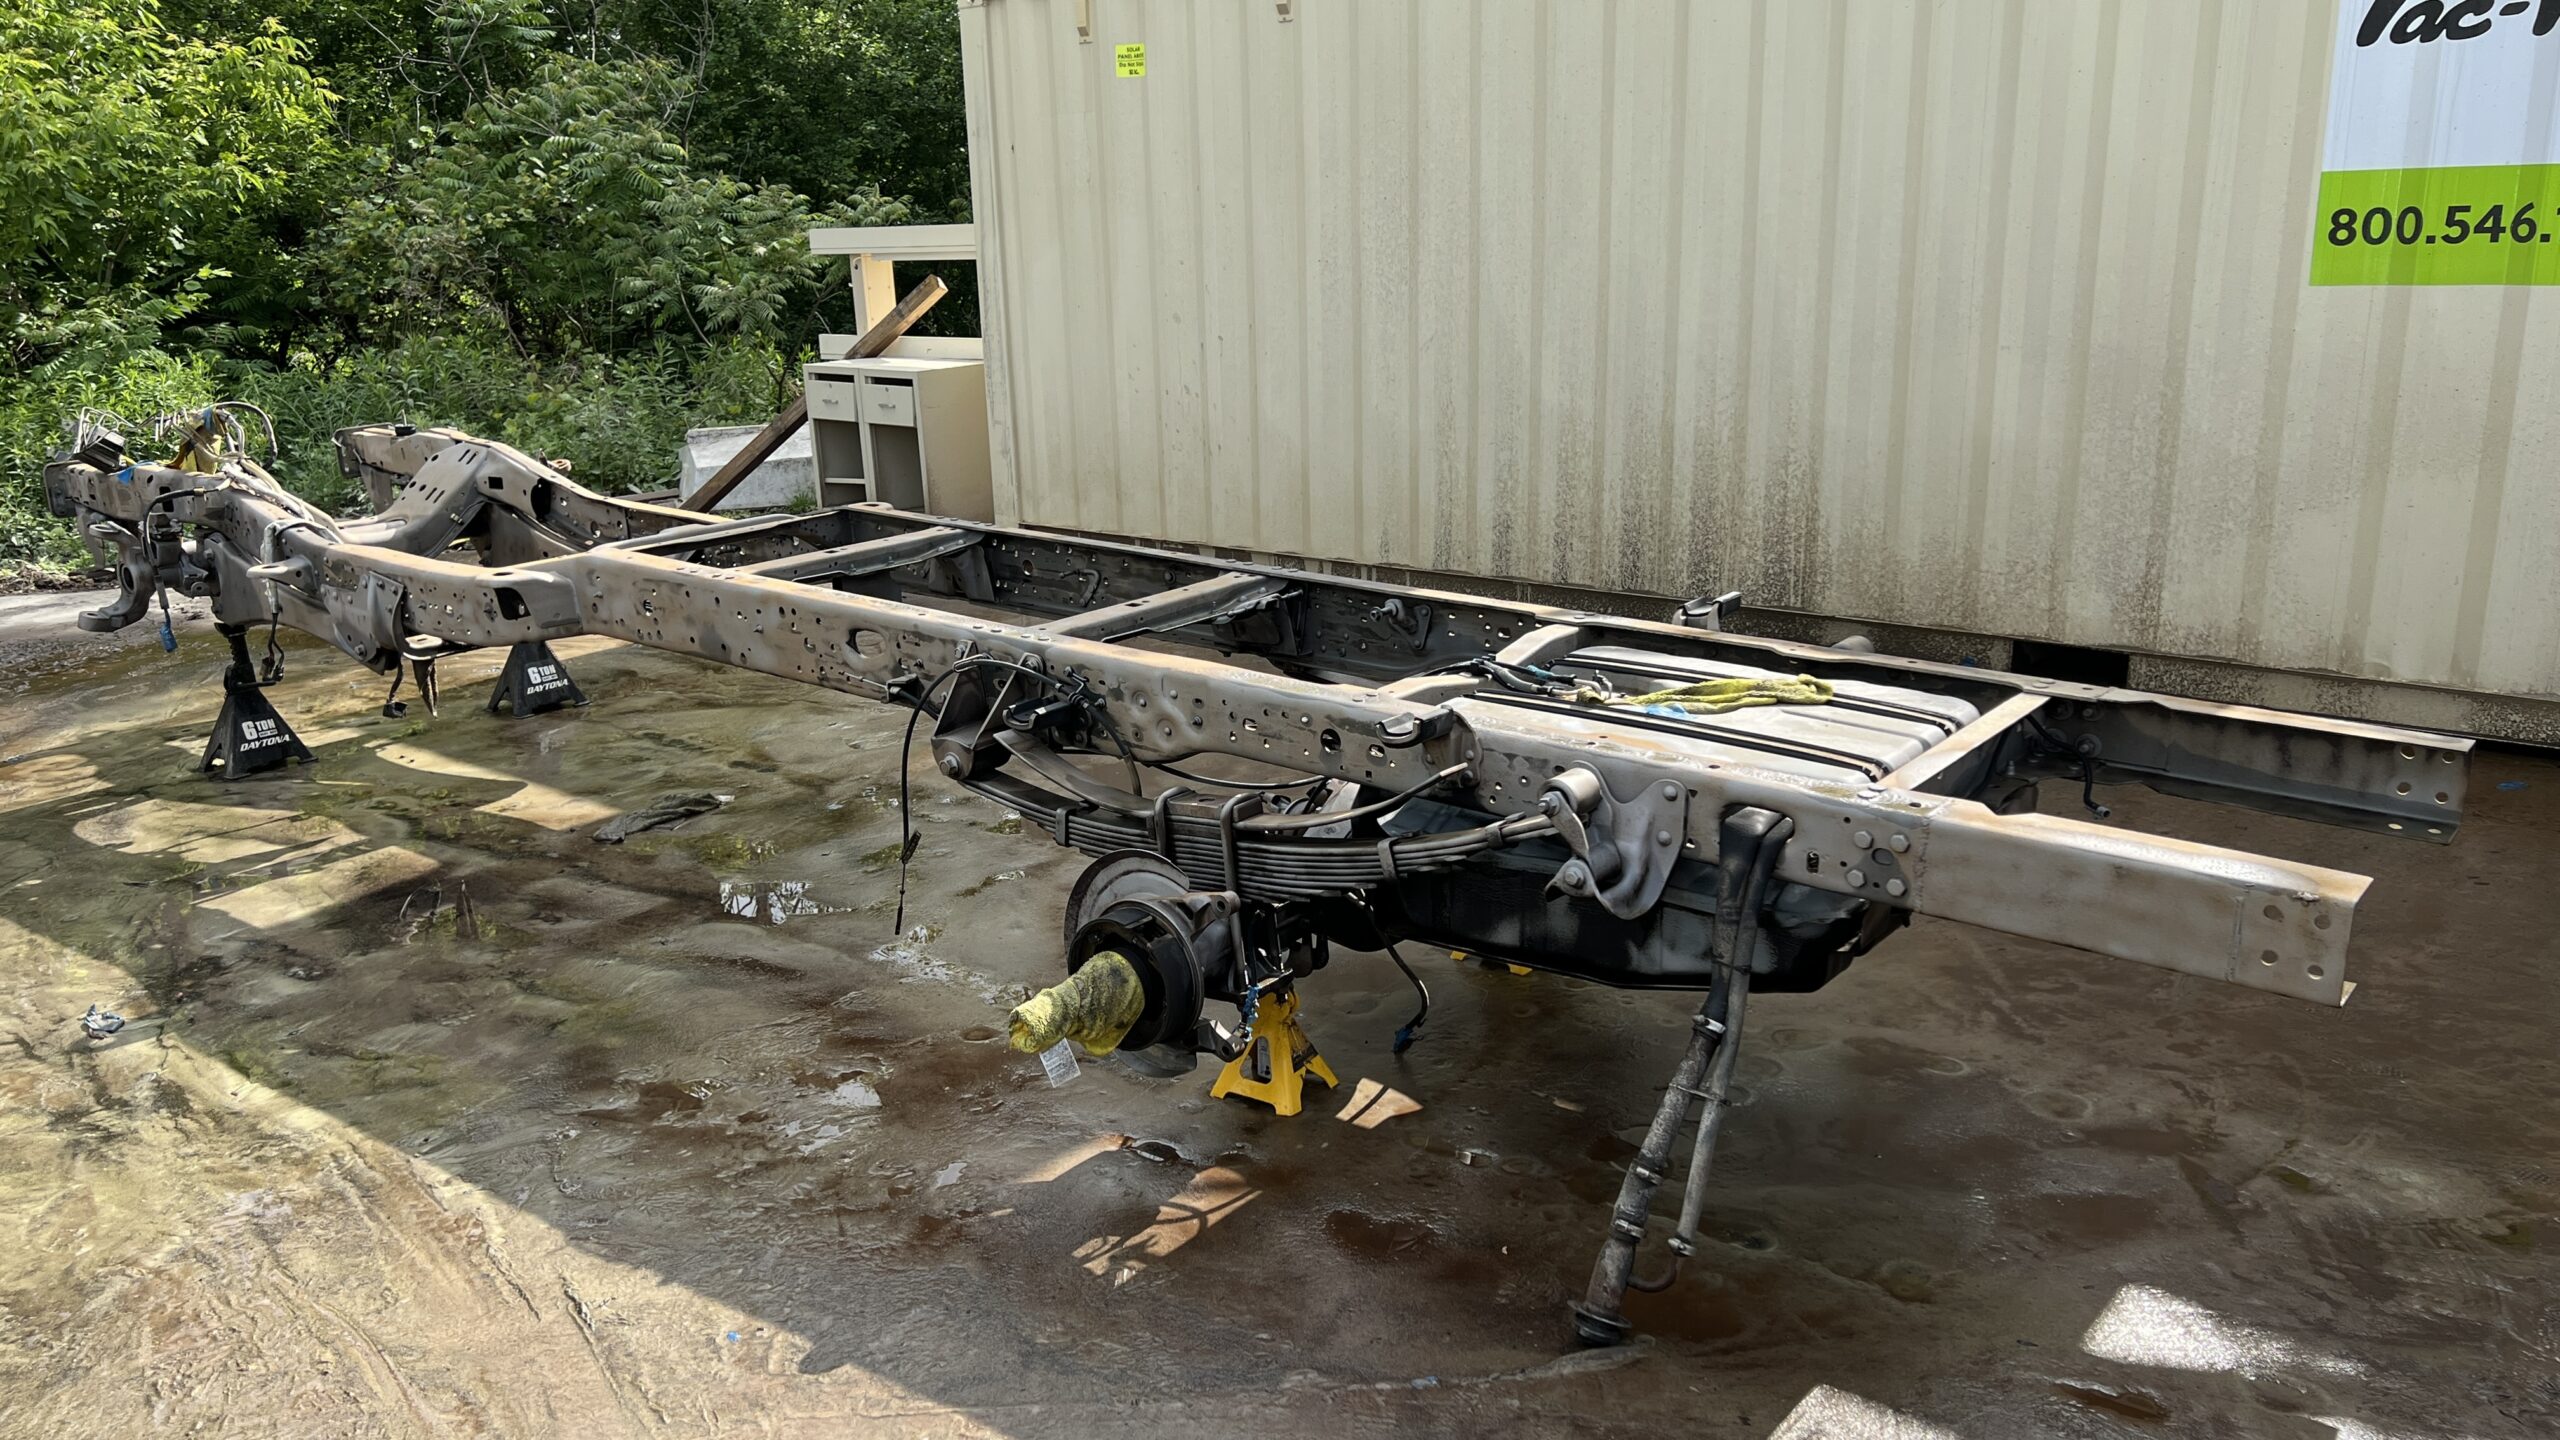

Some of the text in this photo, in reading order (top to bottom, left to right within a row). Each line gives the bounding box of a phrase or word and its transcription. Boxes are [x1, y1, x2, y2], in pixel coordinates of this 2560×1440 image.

[2328, 202, 2560, 246] 800.546.
[527, 666, 542, 684] 6
[538, 664, 556, 676] TON
[527, 678, 569, 695] DAYTONA
[241, 721, 258, 740] 6
[255, 718, 276, 731] TON
[240, 734, 290, 752] DAYTONA
